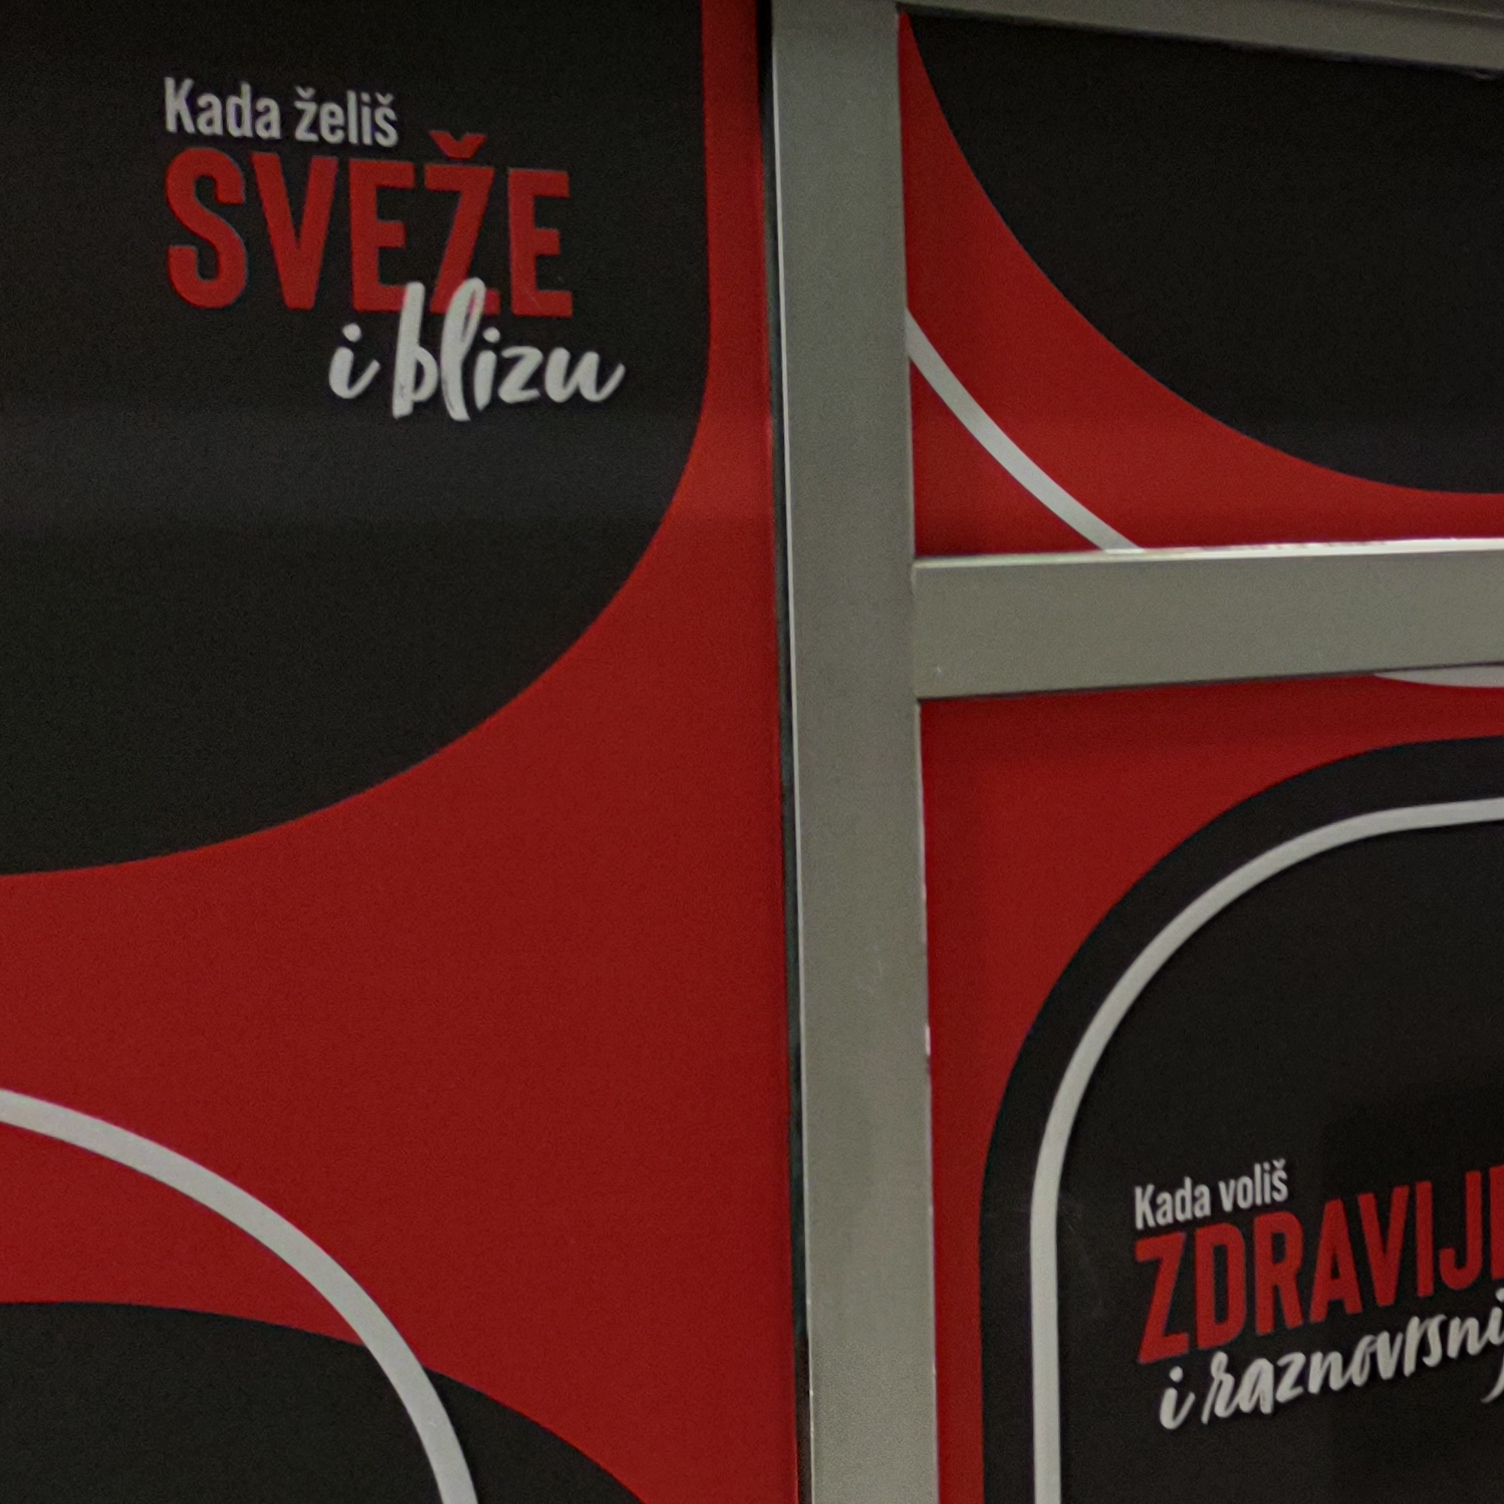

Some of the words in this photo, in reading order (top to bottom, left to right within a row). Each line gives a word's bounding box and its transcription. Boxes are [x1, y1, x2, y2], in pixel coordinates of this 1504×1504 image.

[164, 77, 281, 140] Kada
[294, 88, 398, 148] želiš
[164, 130, 573, 318] SVEŽE
[328, 322, 380, 400] i
[392, 277, 625, 422] blizu
[1134, 1184, 1211, 1230] Kada
[1219, 1159, 1288, 1211] voliš
[1158, 1367, 1195, 1430] i
